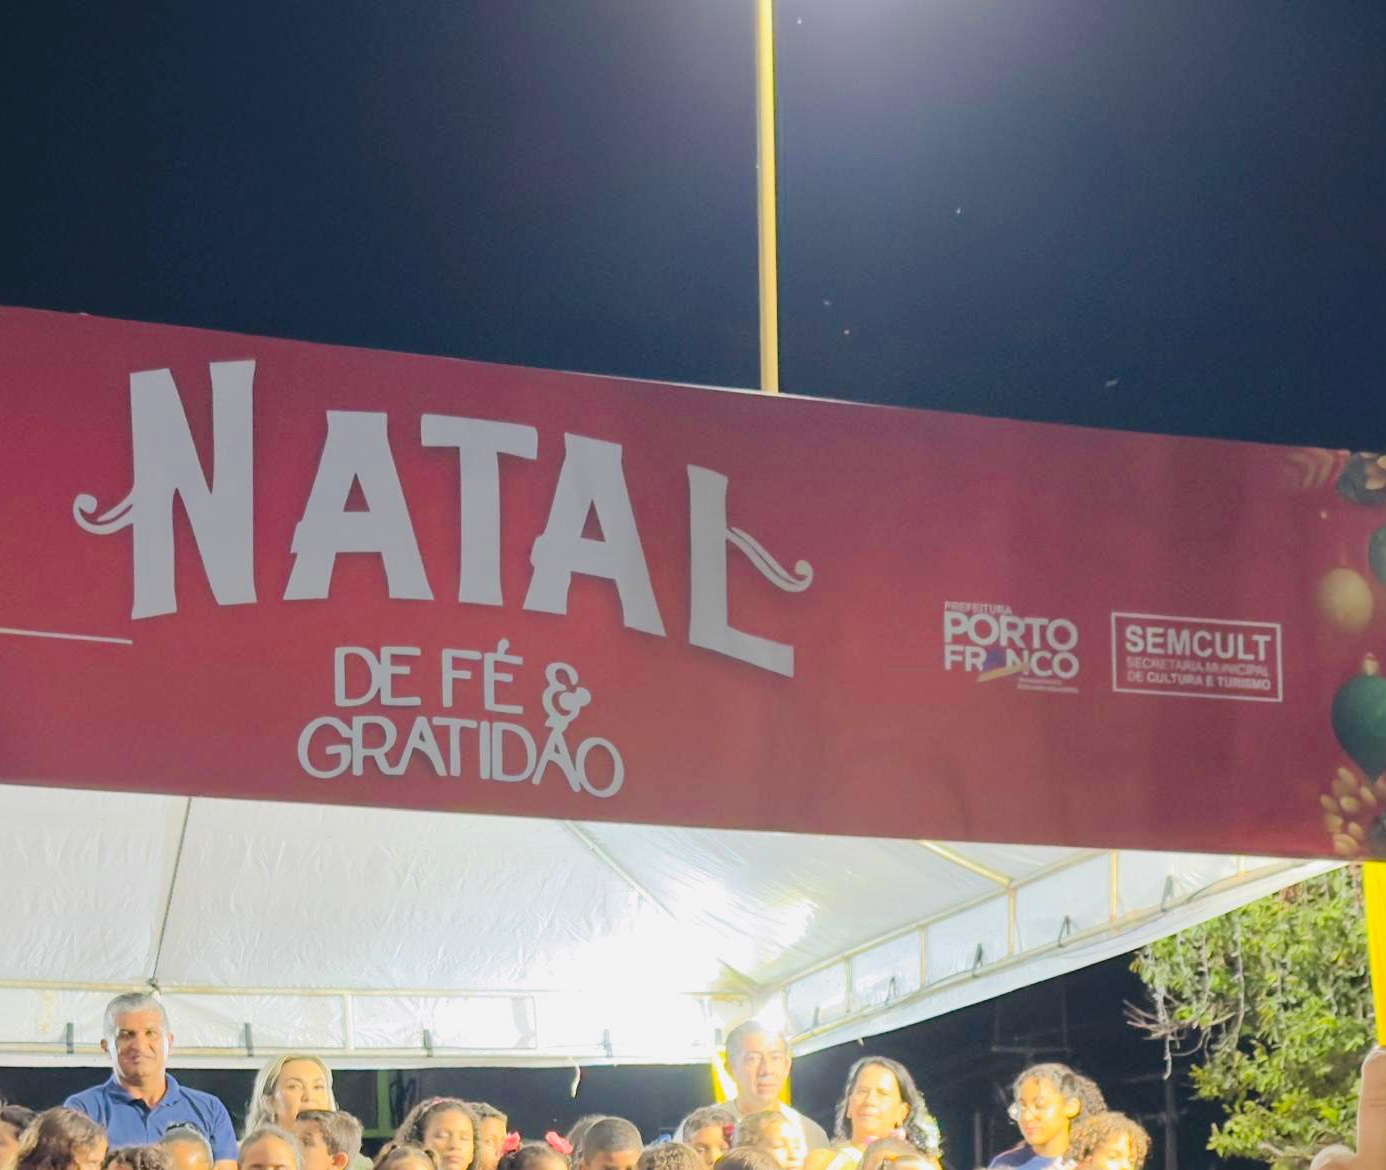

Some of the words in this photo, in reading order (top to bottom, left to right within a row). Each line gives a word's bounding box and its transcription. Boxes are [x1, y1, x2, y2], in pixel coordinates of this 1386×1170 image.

[74, 359, 813, 678] NATAL
[944, 611, 1078, 652] PORTO
[1125, 624, 1272, 661] SEMCULT
[334, 646, 422, 707] DE
[441, 638, 524, 715] FÉ
[541, 661, 592, 728] &
[1126, 656, 1203, 673] SECRETARIA
[1127, 671, 1143, 682] DE
[1146, 672, 1203, 686] CULTURA
[1205, 675, 1214, 687] E
[1218, 676, 1271, 690] TURISMO
